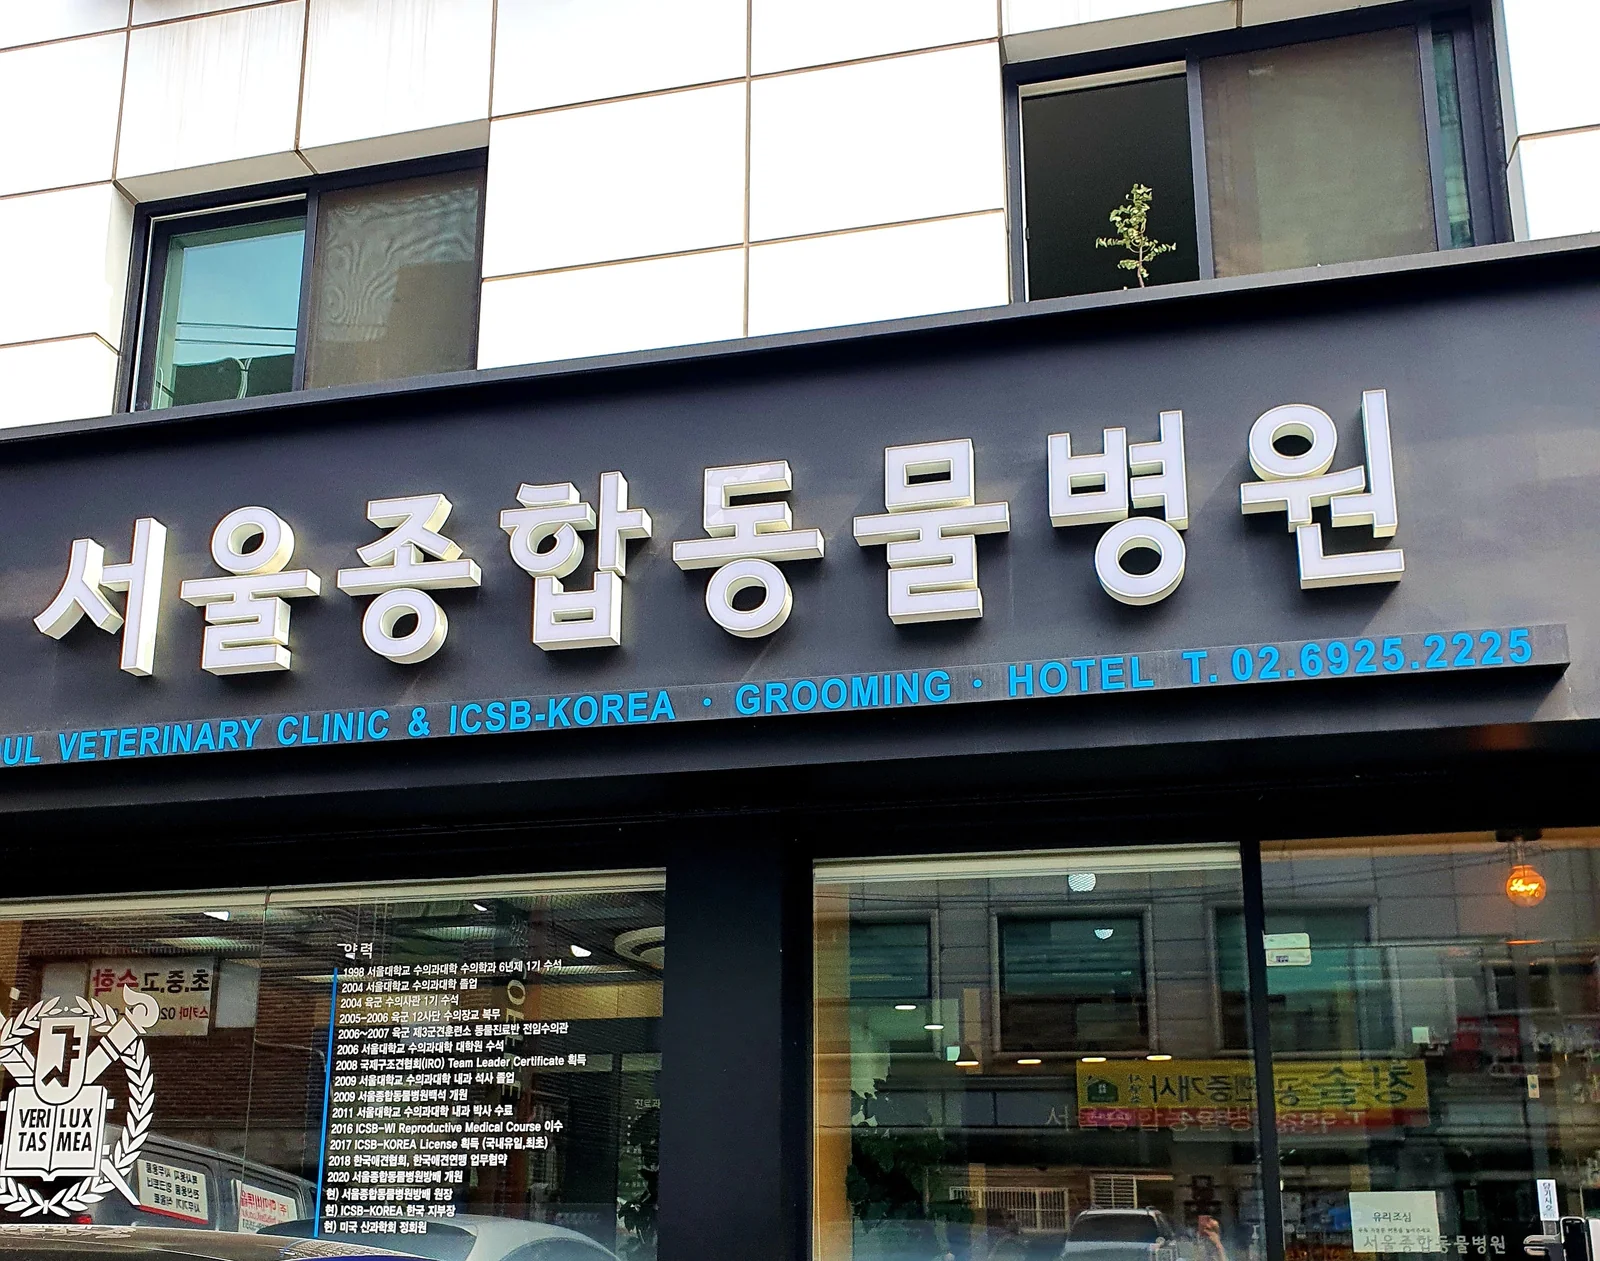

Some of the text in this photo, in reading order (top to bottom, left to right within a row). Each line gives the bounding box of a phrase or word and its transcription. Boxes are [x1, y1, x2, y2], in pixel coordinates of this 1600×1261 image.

[33, 389, 1406, 677] 서울종합동물병원
[0, 628, 1534, 765] UL VETERINARY CLINIC & ICSB-KOREA GROOMING HOTEL T. 02.6925.2225
[344, 967, 364, 977] 1998
[367, 965, 411, 978] 서울대학교
[414, 963, 458, 976] 수의과대학
[526, 960, 541, 973] 1기
[544, 958, 562, 972] 수석
[342, 982, 363, 993] 2004
[366, 980, 410, 993] 서울대학교
[412, 978, 457, 991] 수의과대학
[340, 998, 362, 1008] 2004
[424, 994, 438, 1006] 1기
[441, 994, 459, 1006] 수석
[339, 1013, 388, 1024] 2005-2006
[412, 1010, 440, 1022] 12사단
[336, 1039, 504, 1056] 2006 서울대학교 수의과대학 대학원 수석
[336, 1060, 358, 1071] 2008
[448, 1057, 474, 1069] Team
[476, 1056, 510, 1068] Leader
[513, 1055, 565, 1068] Certificate
[334, 1076, 356, 1087] 2009
[360, 1074, 402, 1087] 서울대학교
[406, 1072, 451, 1086] 수의과대학
[334, 1092, 356, 1103] 2009
[19, 1108, 94, 1129] VERI LUX
[332, 1108, 354, 1119] 2011
[356, 1106, 401, 1119] 서울대학교
[404, 1104, 449, 1118] 수의과대학
[331, 1119, 564, 1135] 2016 ICSB-WI Reproductive Medical Course 이수
[18, 1132, 92, 1151] TAS MEA
[330, 1139, 352, 1150] 2017
[354, 1138, 417, 1150] ICSB-KOREA
[420, 1138, 458, 1150] License
[328, 1156, 351, 1167] 2018
[328, 1172, 350, 1183] 2020
[340, 1205, 404, 1217] ICSB-KOREA
